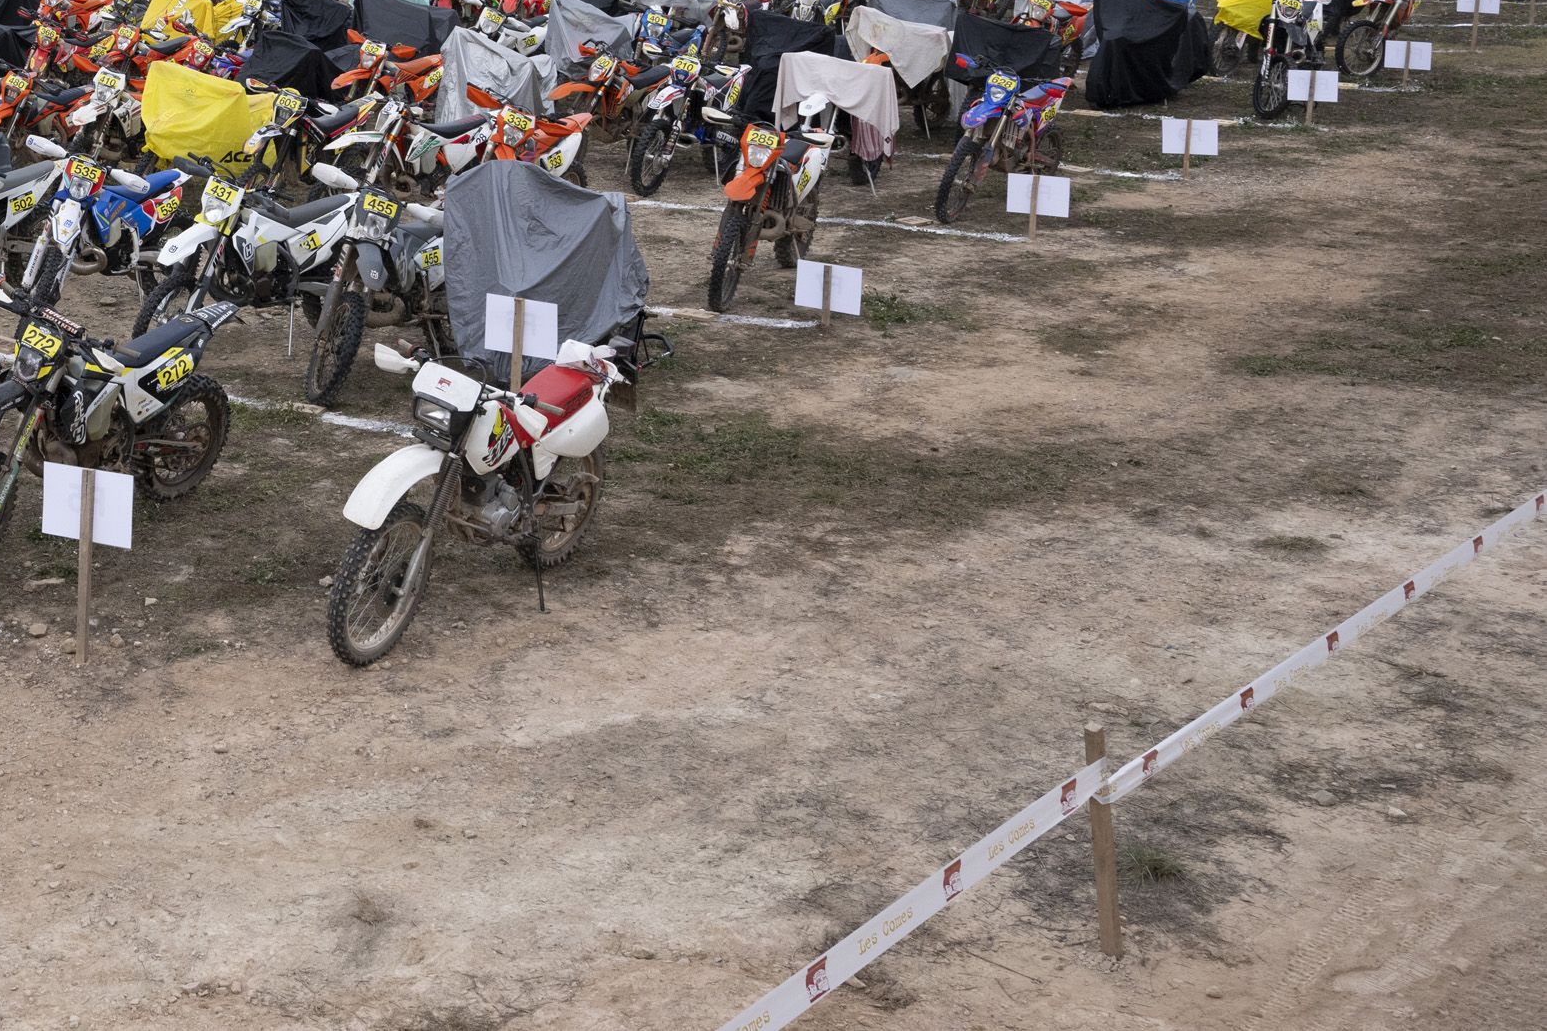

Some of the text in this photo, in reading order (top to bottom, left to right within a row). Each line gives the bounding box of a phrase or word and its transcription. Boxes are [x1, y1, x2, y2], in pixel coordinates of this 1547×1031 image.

[650, 16, 665, 25] 401
[675, 60, 694, 71] 210
[9, 77, 25, 89] 480
[99, 76, 116, 87] 410
[992, 76, 1013, 88] 628
[279, 96, 298, 108] 603
[507, 113, 528, 129] 333
[751, 132, 774, 146] 285
[220, 150, 253, 164] ACE
[74, 164, 99, 180] 535
[211, 184, 232, 200] 431
[13, 196, 33, 210] 502
[160, 199, 178, 217] 535
[368, 198, 393, 214] 455
[300, 237, 318, 250] 31
[424, 251, 439, 264] 455
[23, 329, 56, 355] 272
[163, 359, 190, 386] 272
[988, 817, 1037, 861] Les Comes
[858, 905, 915, 956] Les Comes
